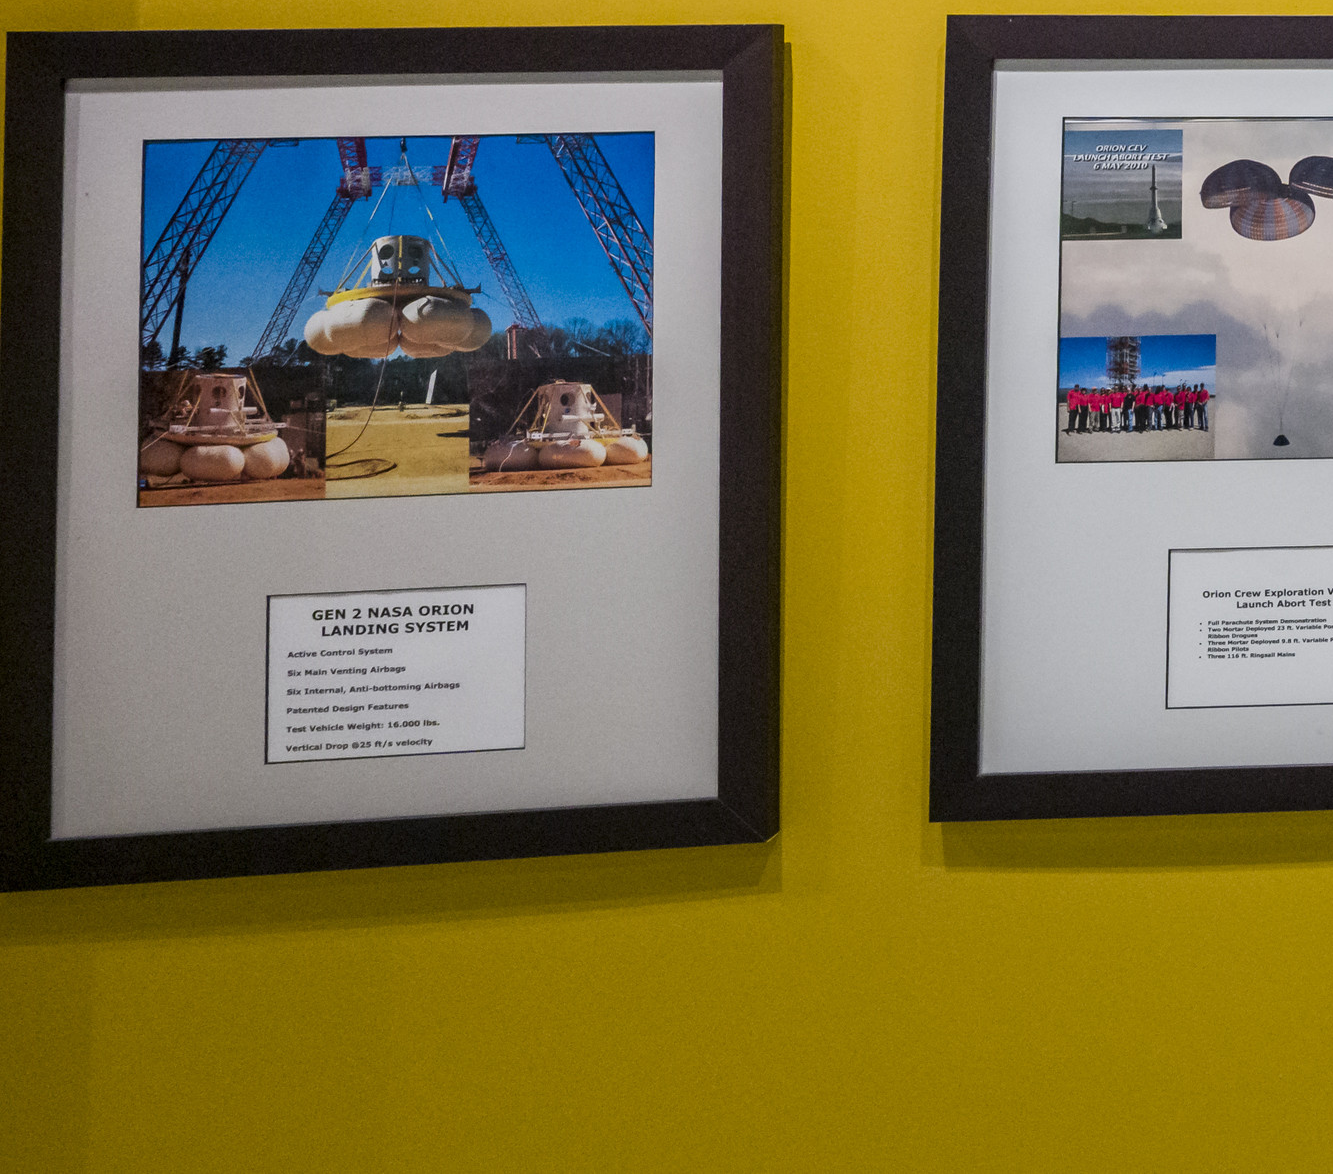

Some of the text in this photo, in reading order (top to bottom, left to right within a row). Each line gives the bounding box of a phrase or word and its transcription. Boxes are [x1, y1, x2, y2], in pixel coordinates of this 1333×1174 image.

[1096, 145, 1126, 153] ORION
[1073, 153, 1169, 162] LAUNCH ABORT TEST
[1101, 162, 1122, 170] MAY
[1124, 162, 1149, 170] 2010
[1202, 589, 1231, 598] Orion
[1234, 589, 1261, 598] Crew
[1264, 587, 1324, 598] Exploration
[1236, 598, 1331, 609] Launch Abort Test
[312, 603, 474, 621] GEN 2 NASA ORION
[321, 620, 469, 637] LANDING SYSTEM
[287, 647, 393, 658] Active Control System
[287, 665, 406, 677] Six Main Venting Airbags
[286, 688, 301, 696] Six
[348, 683, 421, 693] Anti-bottoming
[423, 682, 460, 690] Airbags
[286, 705, 329, 714] Patented
[332, 704, 364, 713] Design
[285, 743, 322, 752] Vertical
[395, 738, 433, 746] velocity
